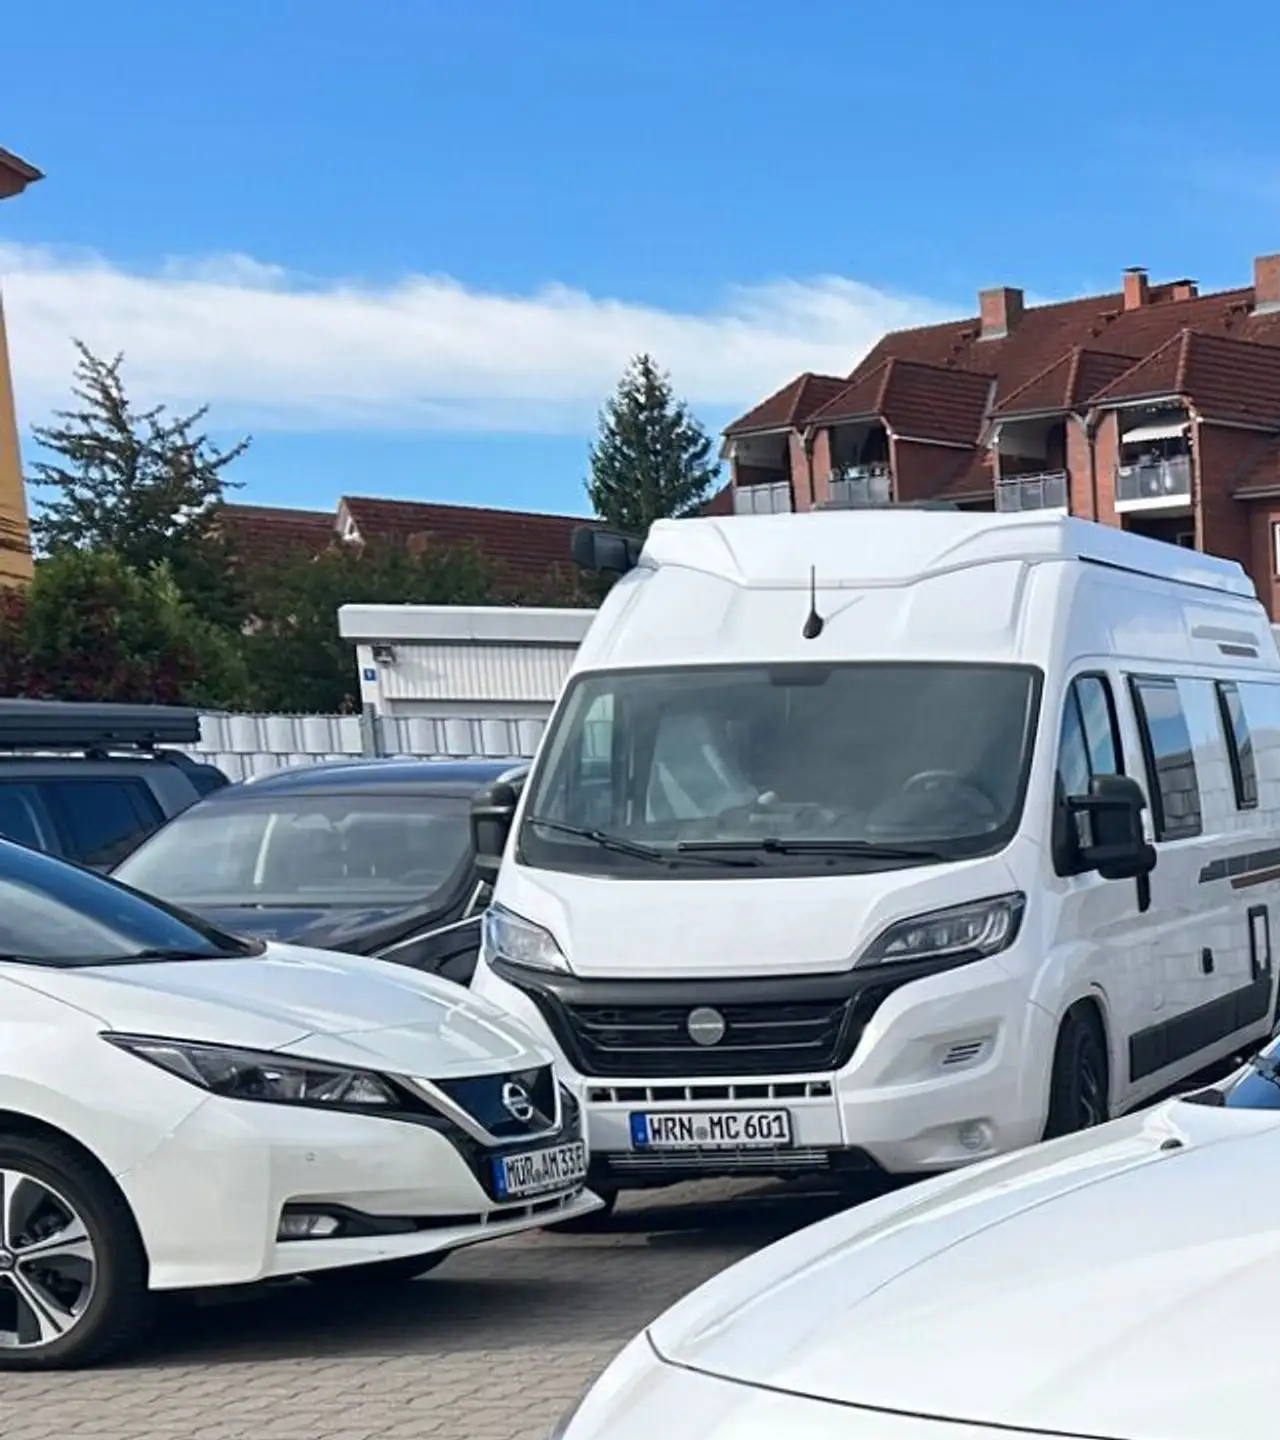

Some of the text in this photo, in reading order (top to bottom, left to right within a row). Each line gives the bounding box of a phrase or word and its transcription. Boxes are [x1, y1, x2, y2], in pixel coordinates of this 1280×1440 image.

[648, 1114, 786, 1141] WRN MC 601
[506, 1155, 535, 1188] MÜR
[541, 1150, 560, 1181] AM
